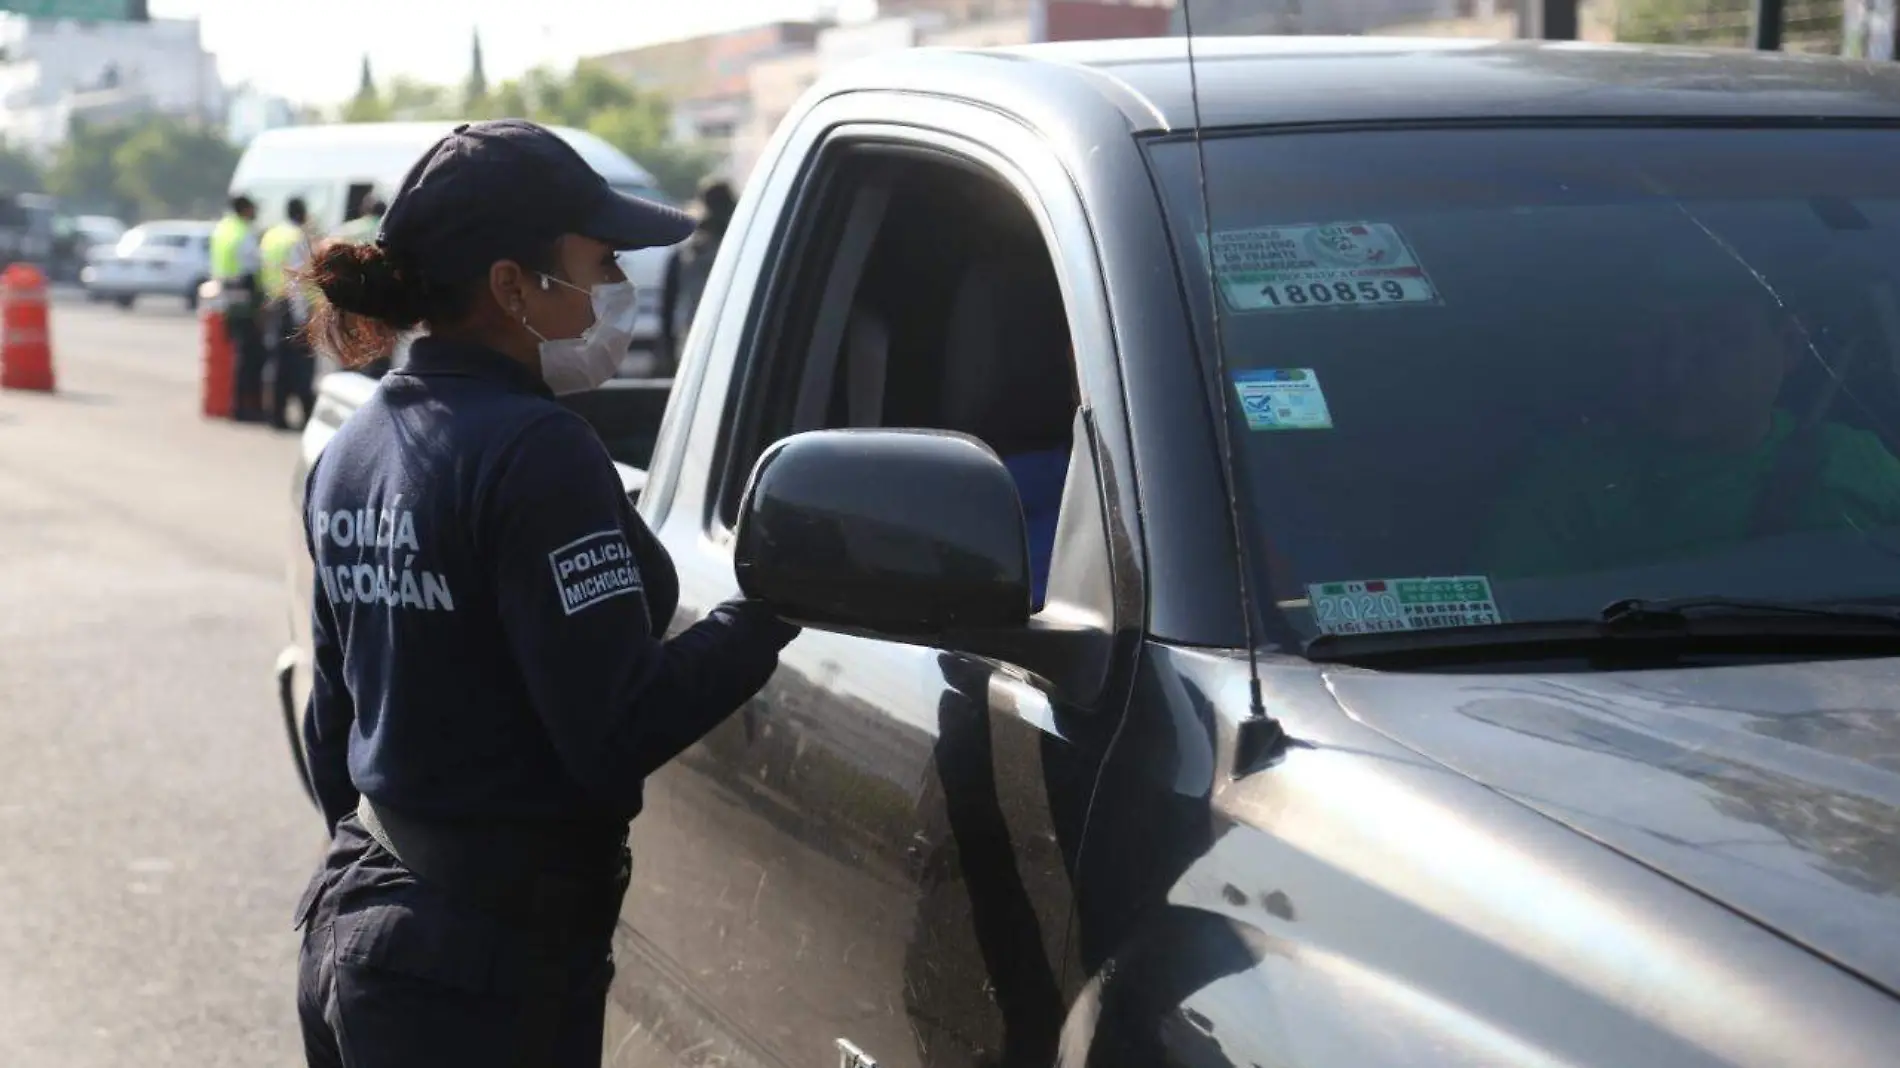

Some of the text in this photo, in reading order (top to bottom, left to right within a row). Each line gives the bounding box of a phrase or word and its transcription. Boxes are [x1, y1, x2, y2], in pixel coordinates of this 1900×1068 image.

[1260, 279, 1405, 306] 180859
[1319, 594, 1398, 622] 2020
[1325, 619, 1405, 634] VIGENCIA
